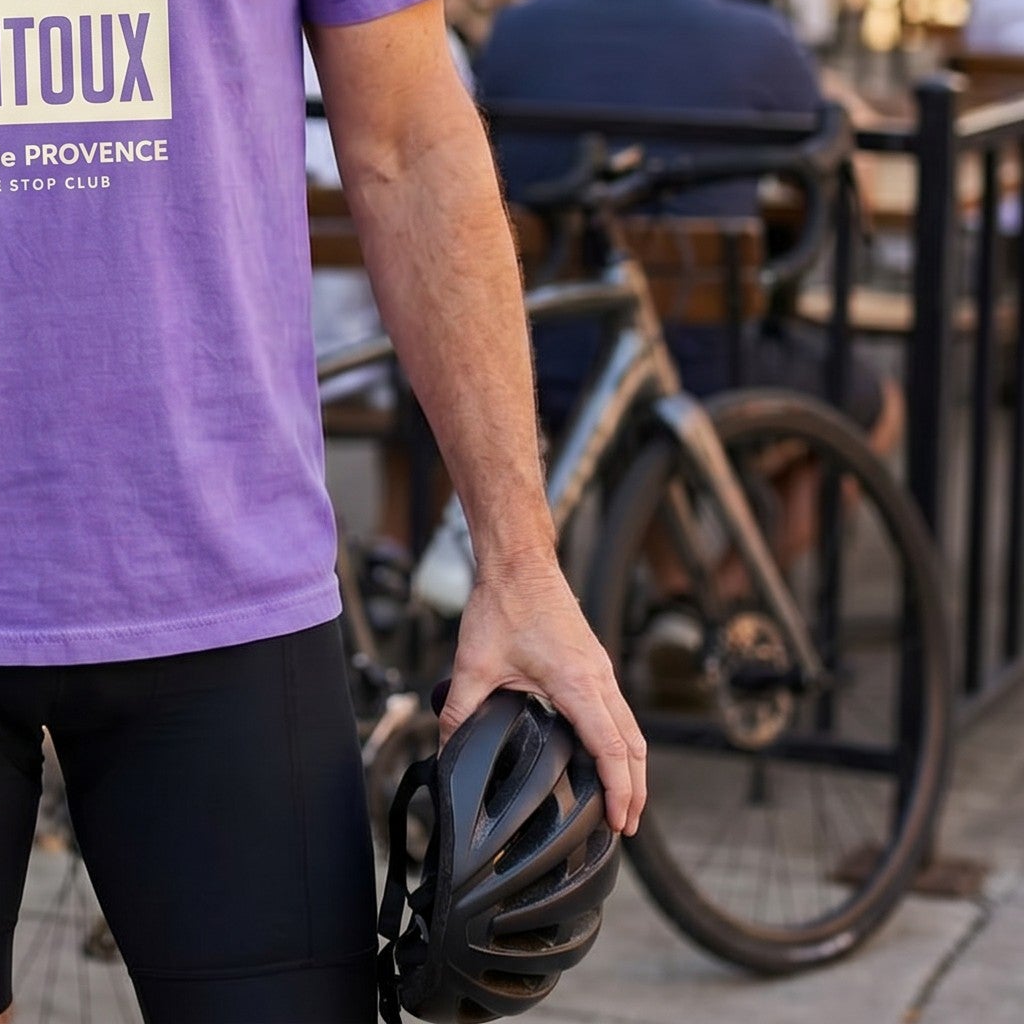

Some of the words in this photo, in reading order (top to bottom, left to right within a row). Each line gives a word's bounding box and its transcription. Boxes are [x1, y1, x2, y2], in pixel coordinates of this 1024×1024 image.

[24, 139, 169, 166] PROVENCE
[9, 177, 57, 192] STOP
[64, 175, 111, 190] CLUB
